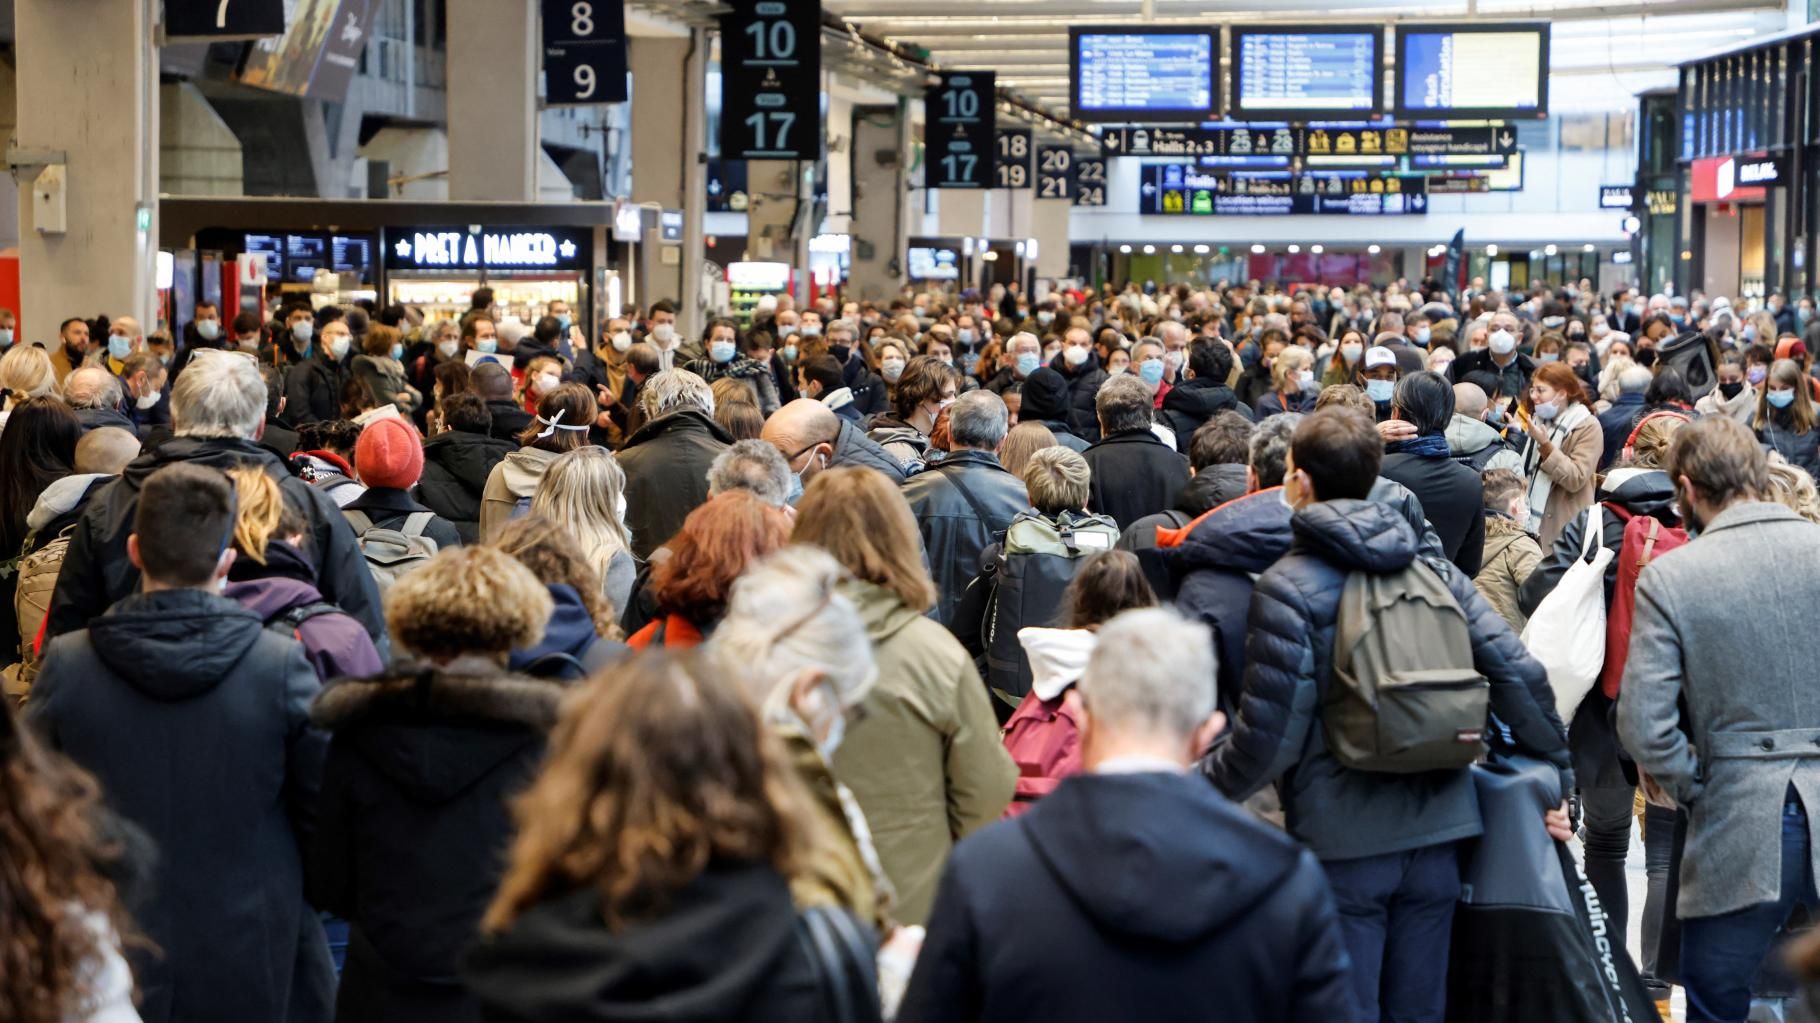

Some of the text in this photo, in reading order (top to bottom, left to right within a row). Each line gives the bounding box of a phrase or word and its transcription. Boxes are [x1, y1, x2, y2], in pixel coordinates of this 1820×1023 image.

[571, 1, 594, 36] 8
[745, 20, 796, 59] 10
[573, 63, 597, 99] 9
[942, 89, 979, 117] 10
[745, 112, 796, 149] 17
[1230, 135, 1251, 149] 25
[999, 135, 1028, 158] 18
[1153, 140, 1185, 153] Halls
[1186, 140, 1196, 153] 2
[1205, 140, 1214, 153] 3
[941, 154, 978, 182] 17
[1041, 150, 1070, 172] 20
[1078, 162, 1104, 180] 22
[998, 164, 1027, 187] 19
[1041, 176, 1067, 198] 21
[1078, 187, 1104, 205] 24
[415, 232, 557, 264] PRET A MANGER
